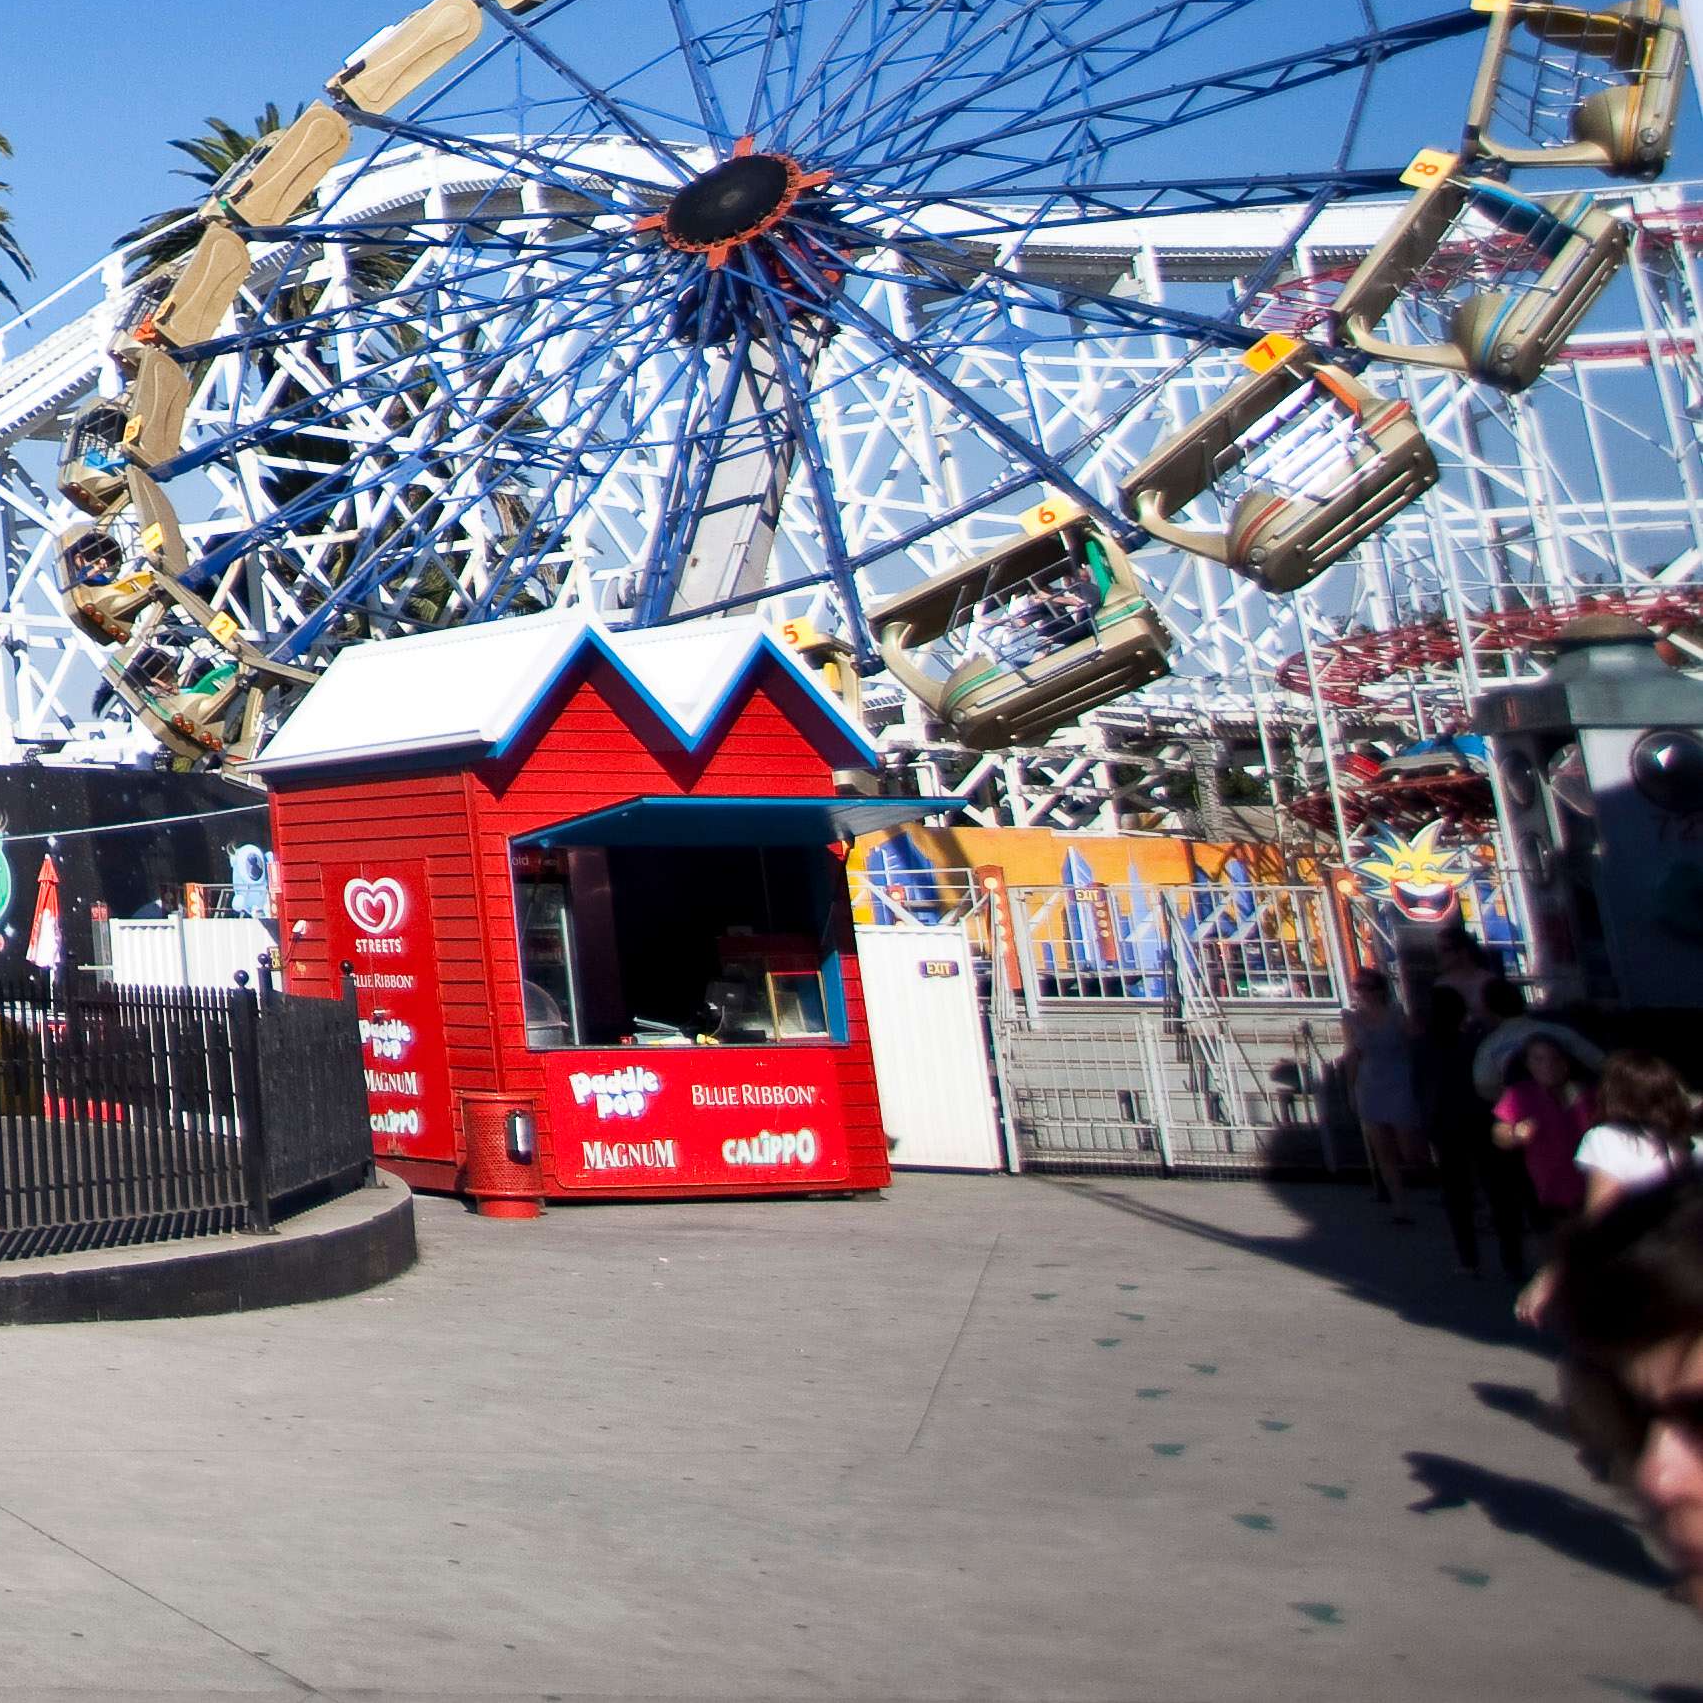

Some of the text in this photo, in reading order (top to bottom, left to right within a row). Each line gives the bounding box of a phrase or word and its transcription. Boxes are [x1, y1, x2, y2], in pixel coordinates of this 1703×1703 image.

[1413, 162, 1438, 176] 8
[1254, 341, 1277, 360] 7
[1038, 506, 1056, 525] 6
[215, 620, 230, 635] 2
[783, 624, 799, 645] 5
[1075, 889, 1099, 902] EXIT
[355, 937, 402, 954] STREETS
[926, 962, 950, 976] EXIT
[363, 1069, 419, 1096] MAGNUM
[691, 1084, 739, 1106] BLUE
[581, 1139, 677, 1171] MAGNUM
